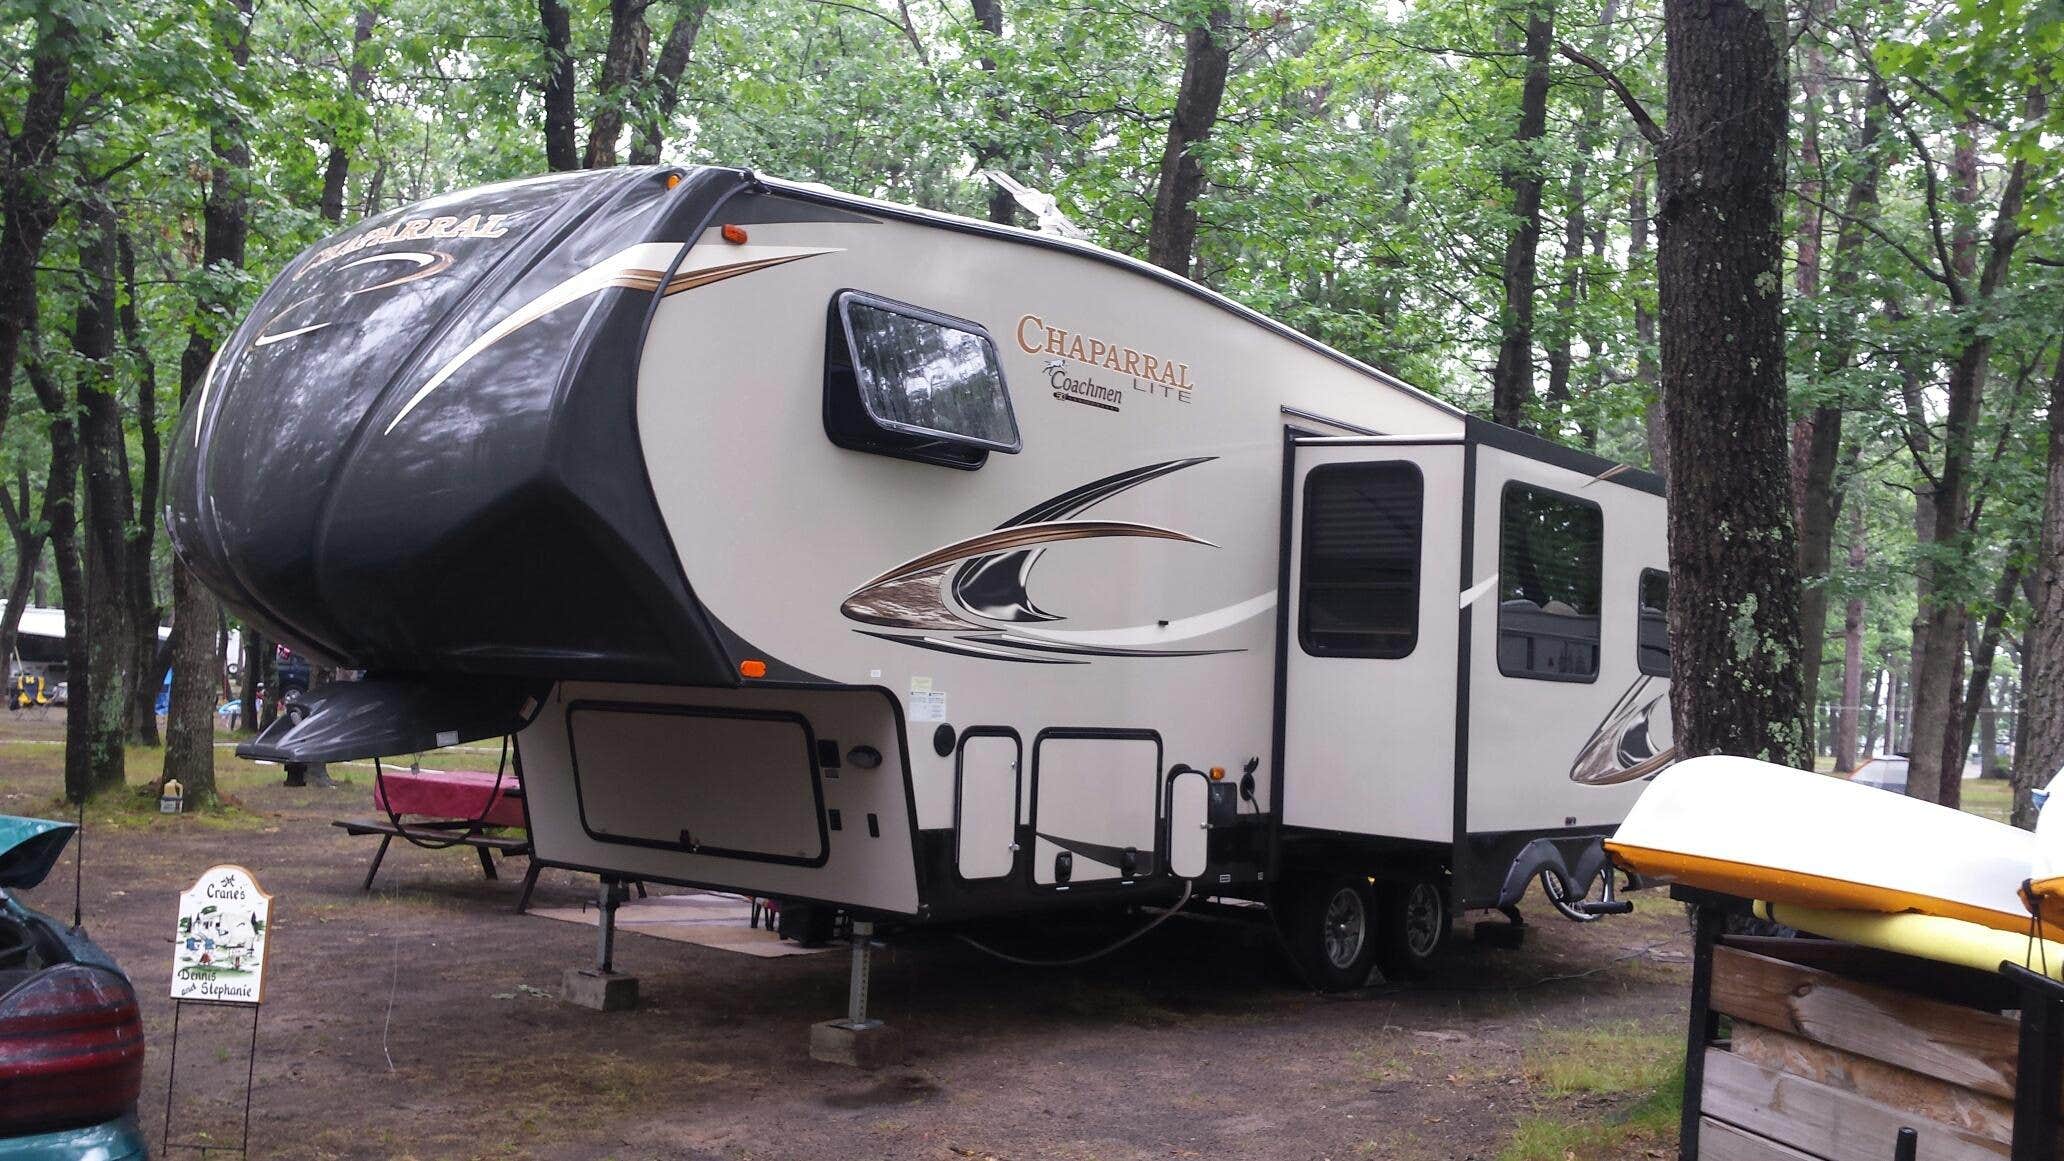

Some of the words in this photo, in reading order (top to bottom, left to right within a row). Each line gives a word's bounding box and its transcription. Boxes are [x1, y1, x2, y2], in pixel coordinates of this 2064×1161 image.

[1017, 314, 1194, 391] CHAPARRAL
[1051, 370, 1122, 404] Coachmen
[1133, 378, 1192, 404] LITE
[207, 884, 246, 900] Crane's
[177, 968, 217, 982] Dennis
[201, 982, 252, 999] Stephanie
